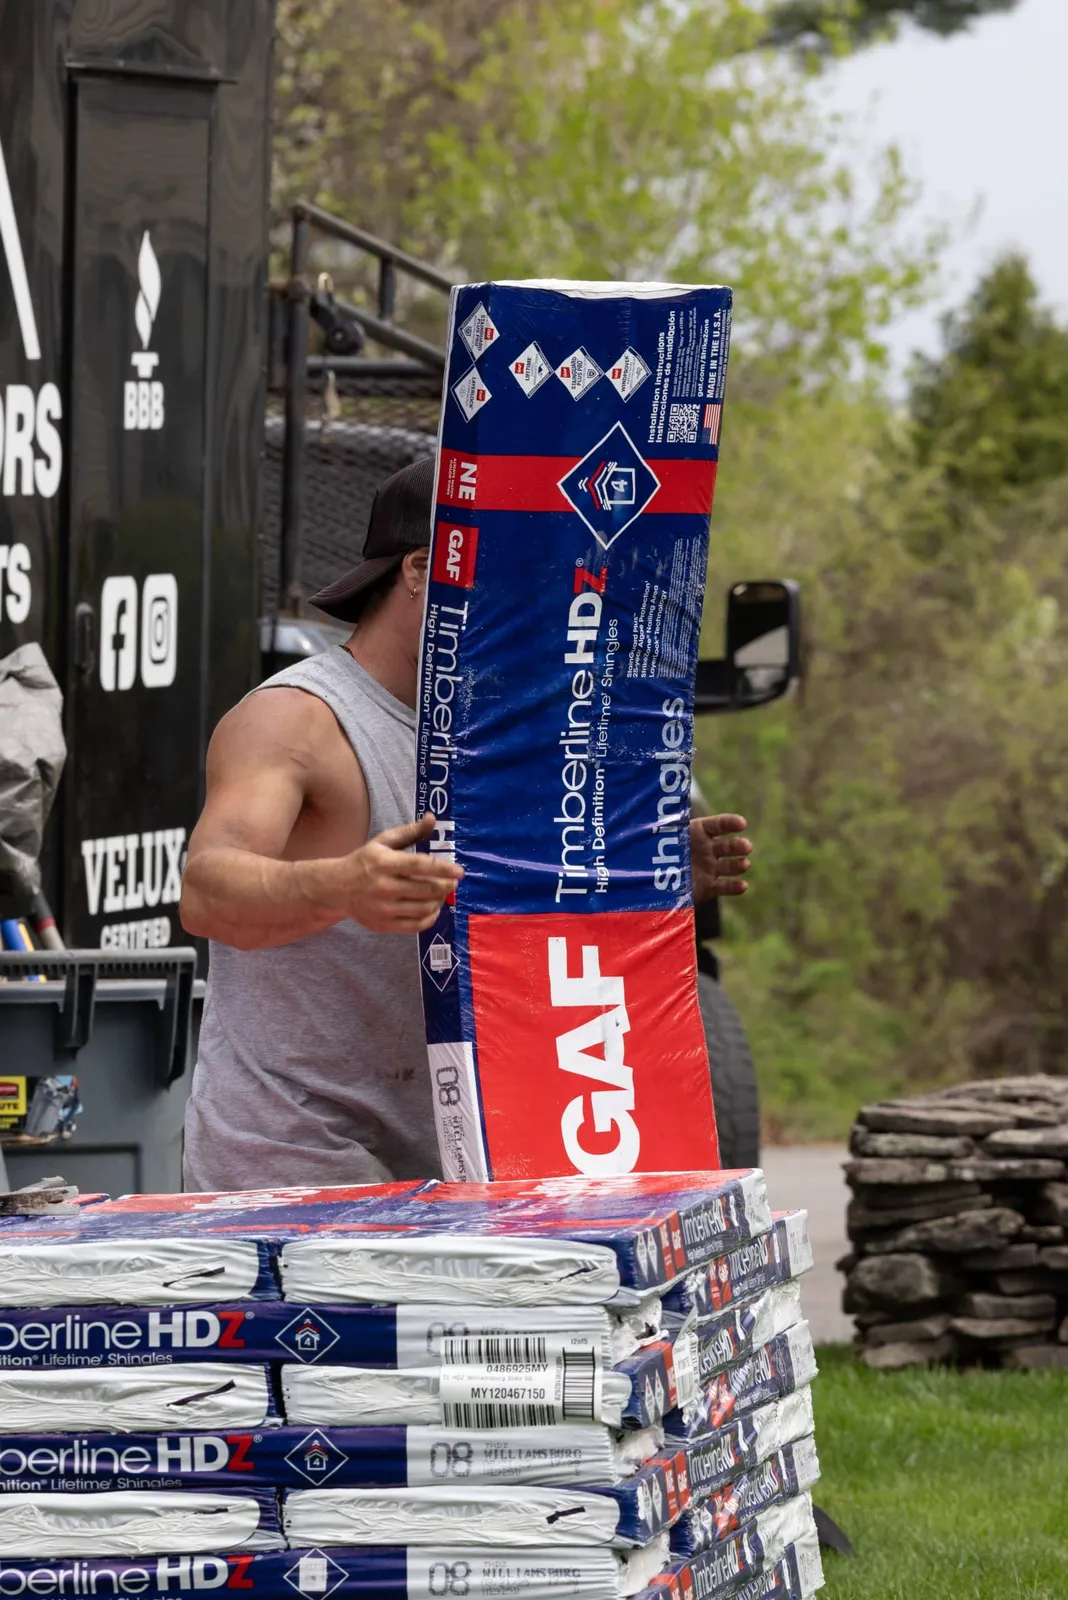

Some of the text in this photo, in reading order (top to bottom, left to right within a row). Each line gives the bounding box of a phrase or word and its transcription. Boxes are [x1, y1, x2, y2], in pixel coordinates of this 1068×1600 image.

[706, 308, 721, 398] MADE IN THE U.S.A.
[123, 381, 164, 430] BBB
[647, 388, 660, 443] Installation
[655, 377, 670, 443] Instrucciones
[664, 362, 671, 376] de
[0, 382, 63, 498] RS
[458, 462, 478, 500] NE
[446, 529, 464, 581] GAF
[650, 585, 659, 604] Area
[654, 590, 668, 635] Technology
[427, 604, 439, 638] High
[637, 624, 645, 648] Algae
[646, 605, 656, 633] Nailing
[600, 618, 620, 688] Shingles
[429, 601, 469, 814] Timberline
[417, 782, 427, 822] Shing
[554, 669, 594, 903] Timberline
[81, 827, 186, 916] VELUX
[592, 855, 609, 893] High
[548, 937, 640, 1178] GAF
[436, 1066, 461, 1107] 08
[108, 1352, 173, 1366] Shingles
[486, 1364, 548, 1373] 0486925MY
[471, 1388, 545, 1400] MY120467150
[430, 1442, 474, 1477] 08
[484, 1449, 582, 1460] WILLIAMSBURG
[117, 1477, 182, 1490] Shingles
[428, 1561, 472, 1597] 08
